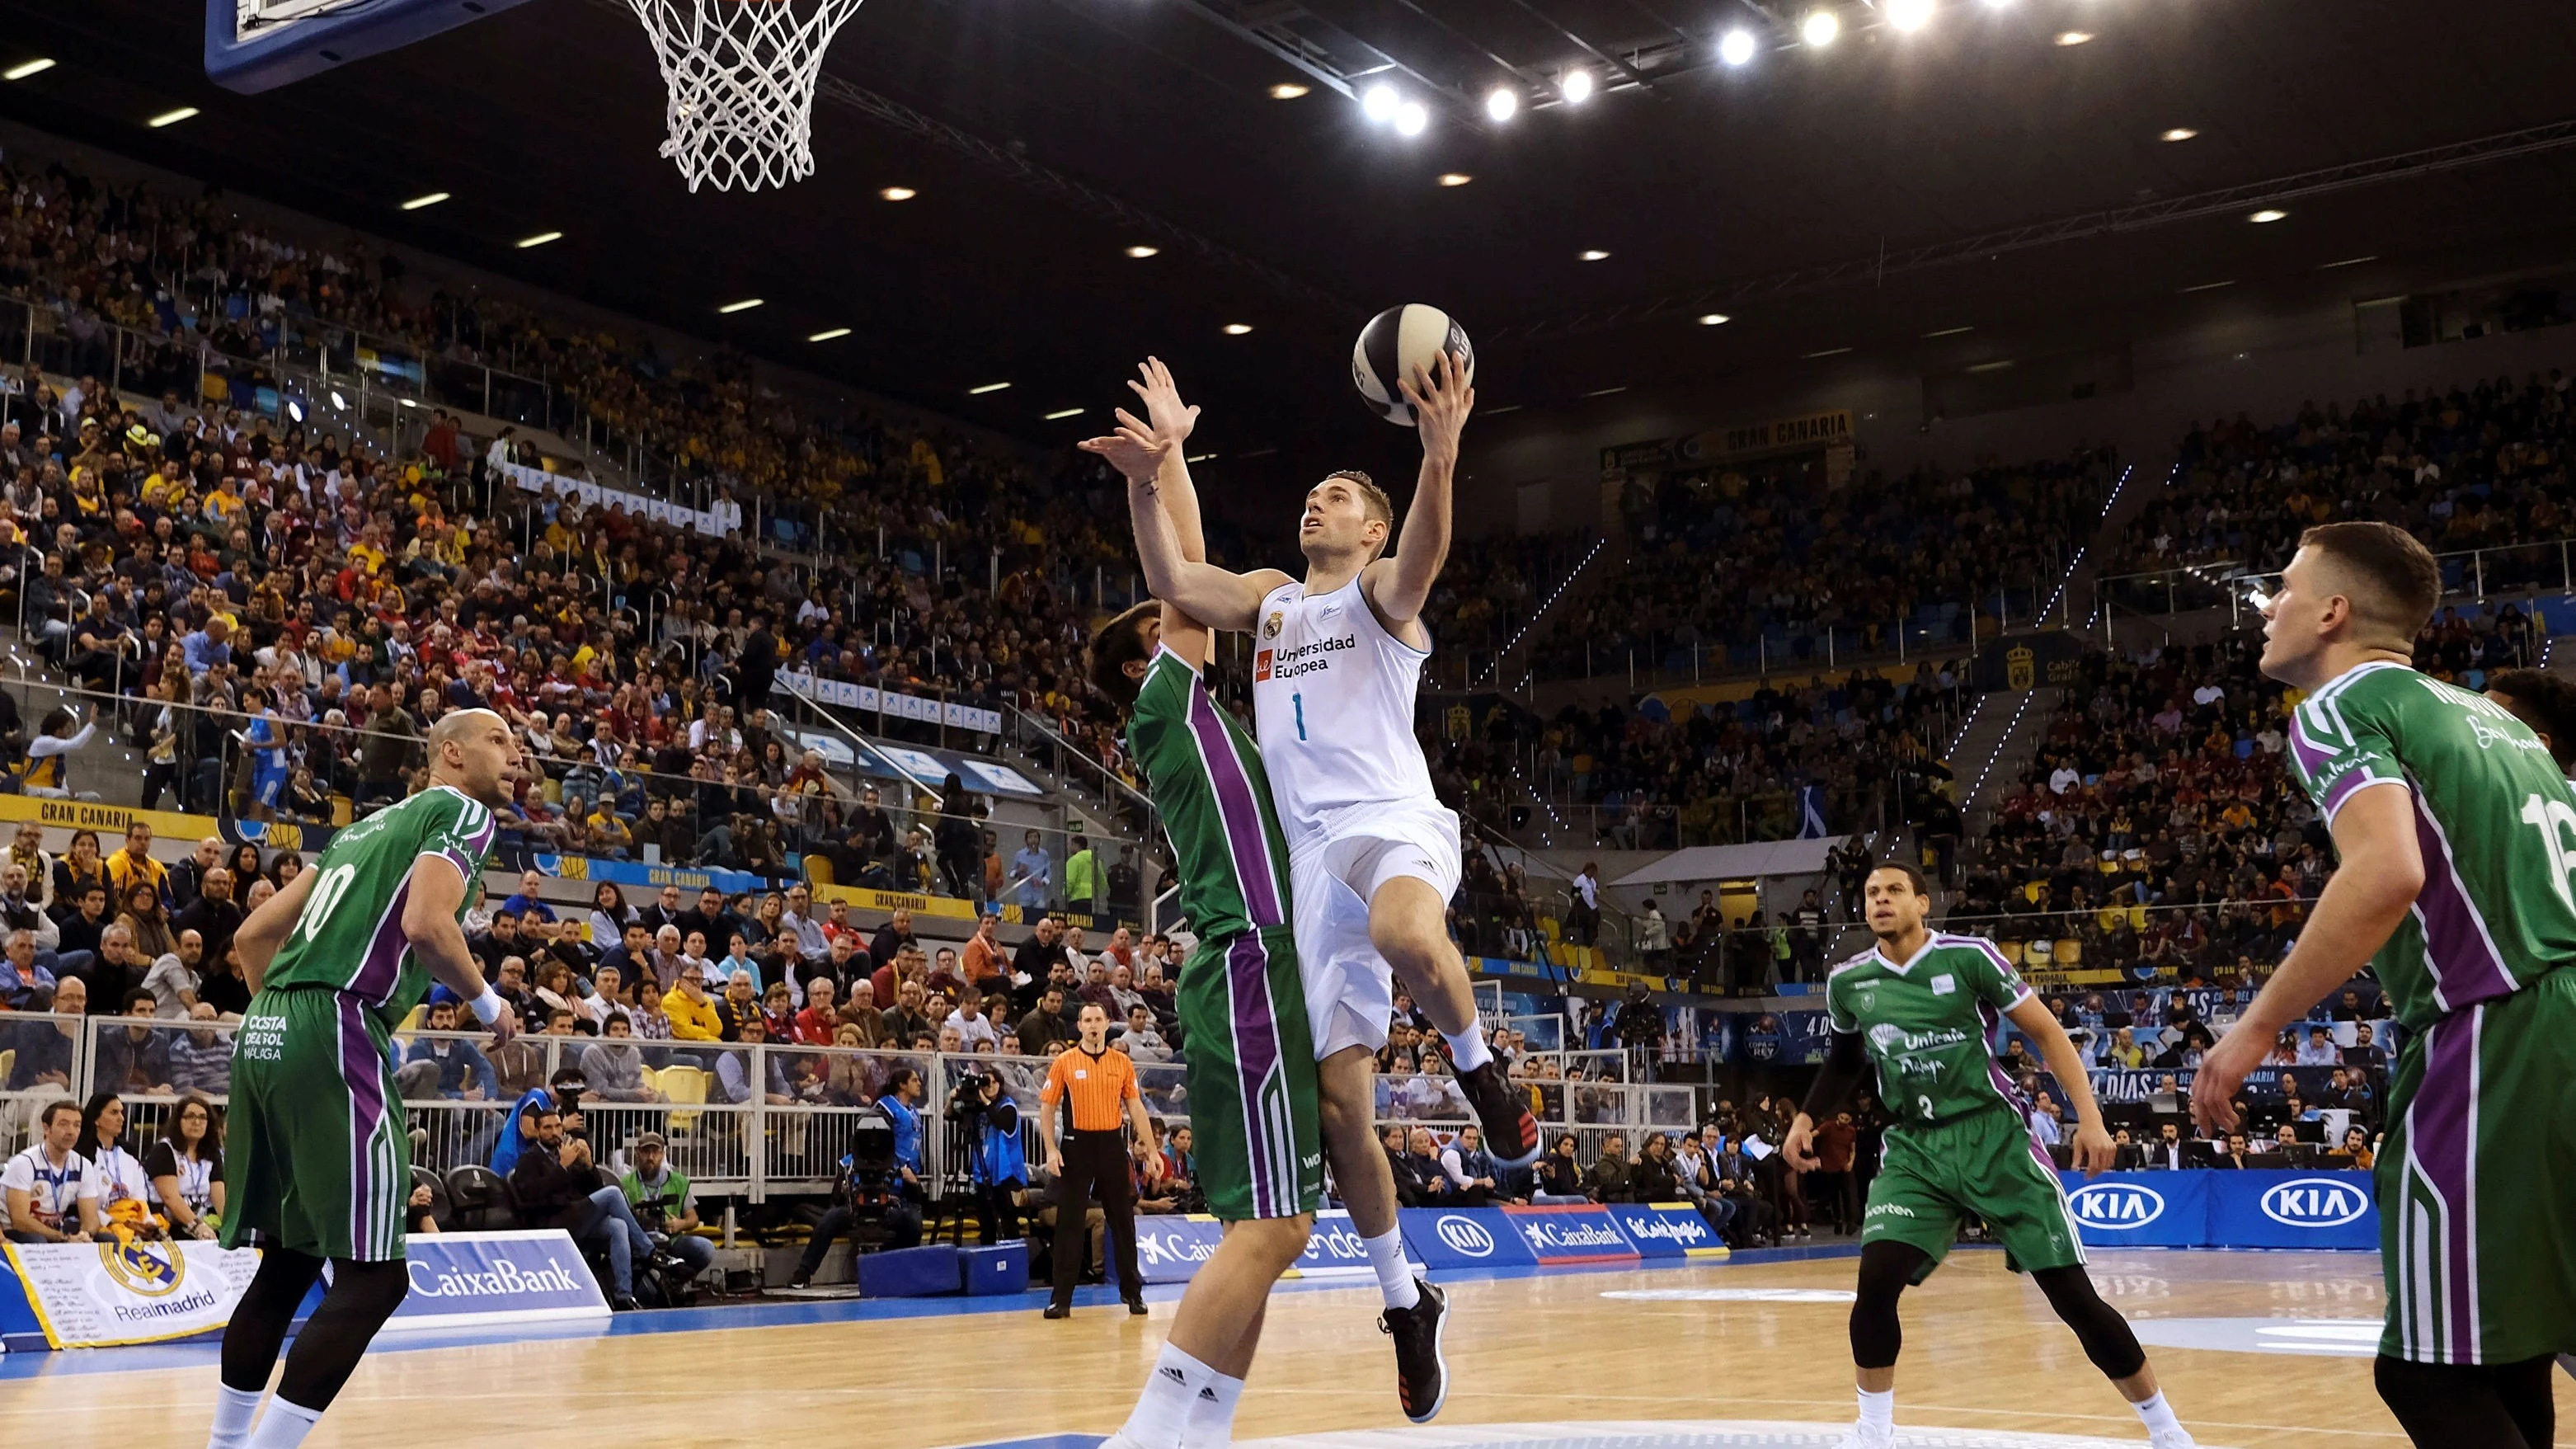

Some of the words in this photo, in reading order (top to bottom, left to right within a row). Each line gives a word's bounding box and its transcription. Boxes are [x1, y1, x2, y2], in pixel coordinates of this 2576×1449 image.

[1728, 426, 1769, 451] GRAN
[1777, 414, 1847, 443] CANARIA
[1276, 633, 1356, 662] Unersidad
[1275, 658, 1329, 680] Euopea
[1292, 692, 1307, 741] 1
[2312, 748, 2382, 807] ndalucía
[42, 802, 75, 824] GRAN
[81, 807, 134, 828] CANARIA
[649, 868, 670, 884] GRAN
[674, 871, 711, 888] CANARIA
[896, 895, 927, 910] CANARIA
[249, 1015, 287, 1032] COSTA
[1806, 1016, 1817, 1037] 4
[245, 1033, 261, 1046] DEL
[262, 1033, 284, 1047] SOL
[1754, 1047, 1775, 1056] REY
[2106, 1070, 2151, 1099] DÍAS
[2081, 1193, 2146, 1220] KIA
[2279, 1189, 2350, 1217] KIA
[1442, 1224, 1489, 1248] KIA
[1545, 1222, 1624, 1247] CaixaBank
[407, 1257, 582, 1300] CaixaBank
[114, 1291, 215, 1322] Realmadrid
